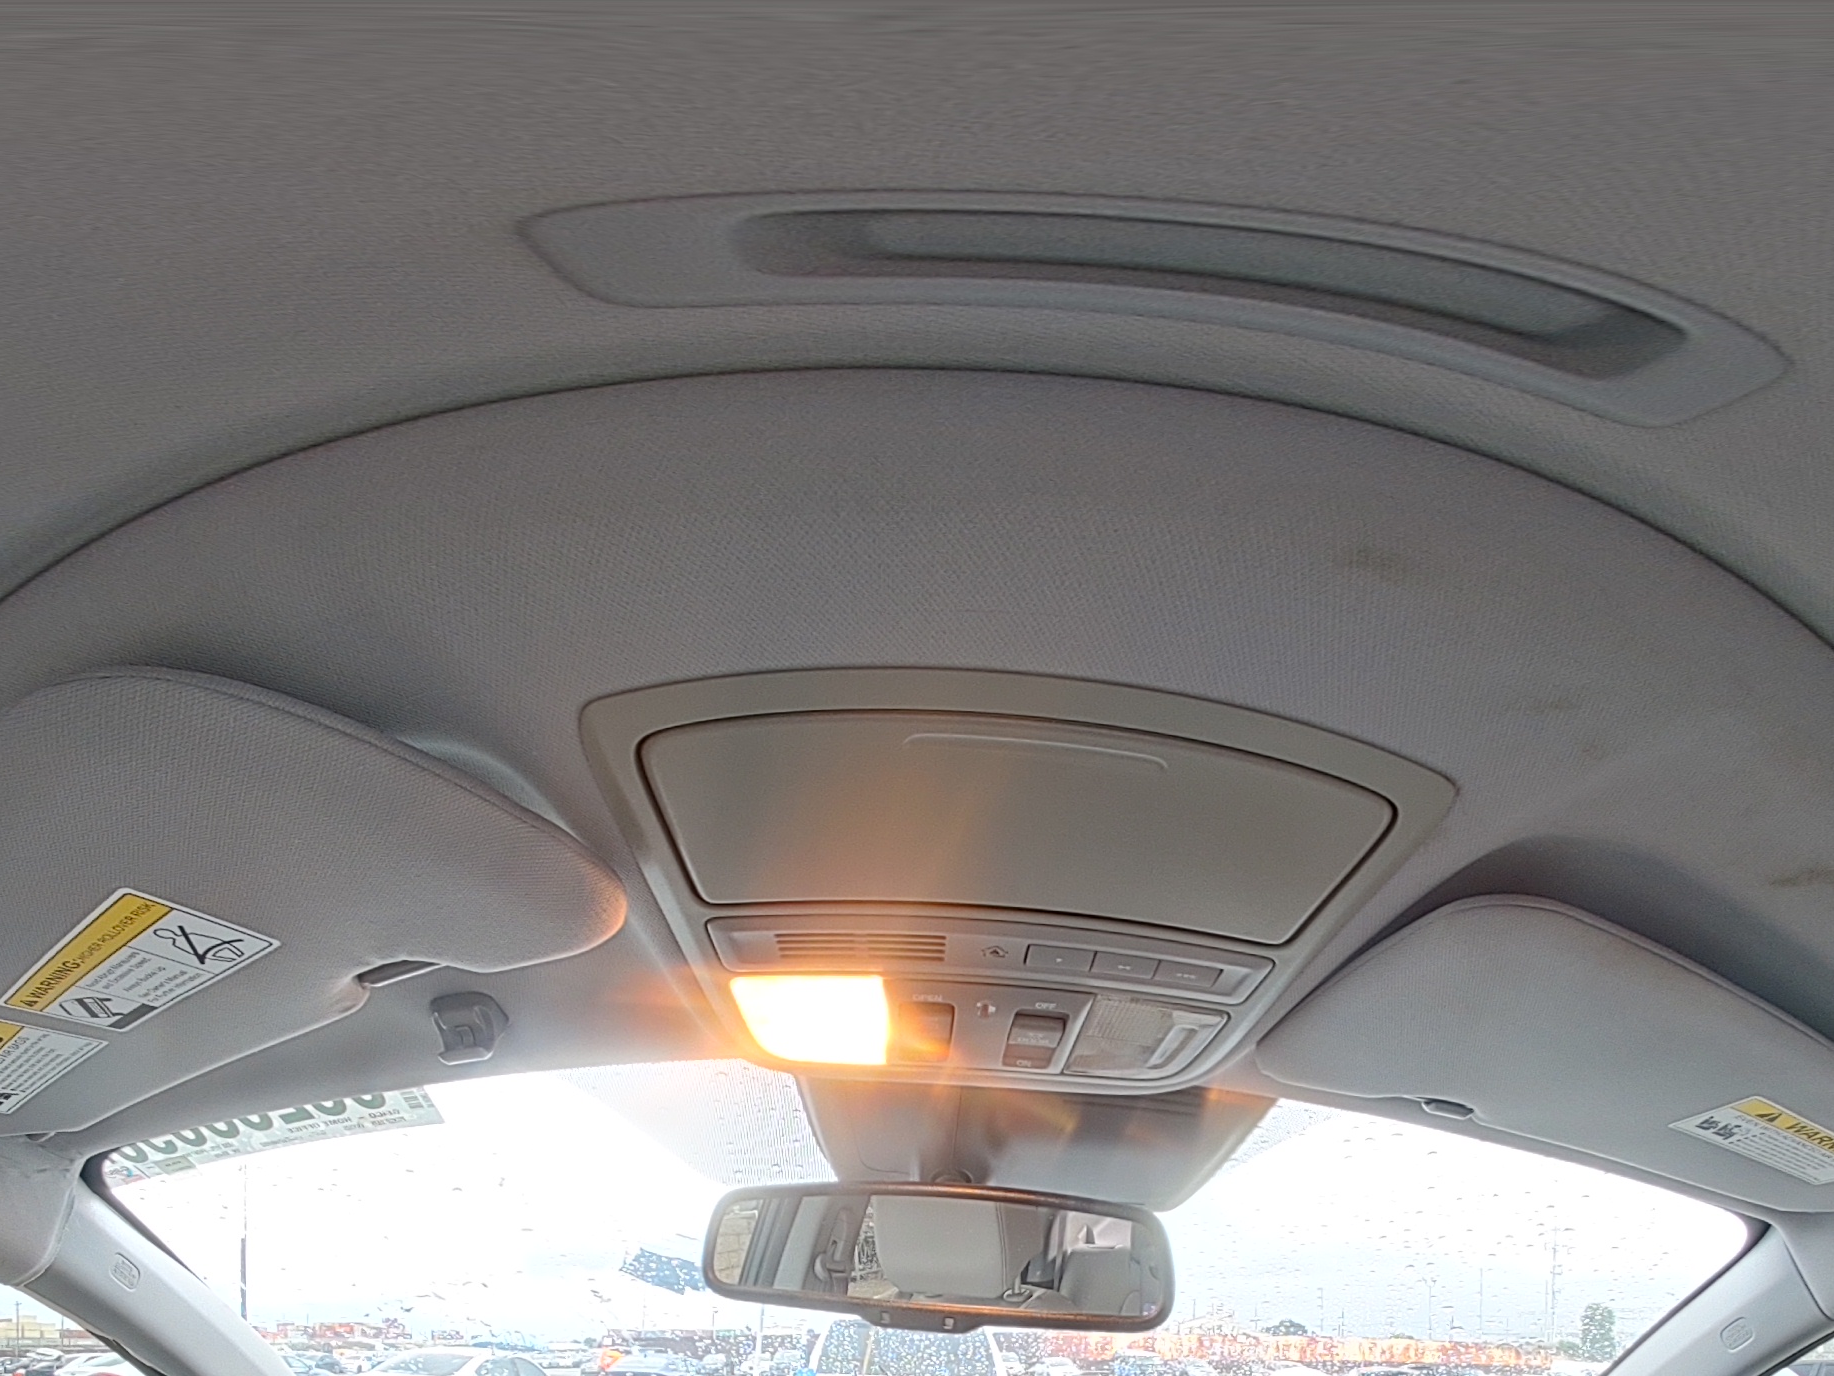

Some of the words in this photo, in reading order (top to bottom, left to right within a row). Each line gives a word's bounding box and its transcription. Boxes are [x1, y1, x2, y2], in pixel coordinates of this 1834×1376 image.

[100, 915, 135, 945] ROLLOVER
[912, 993, 943, 1002] OPEN
[1016, 1059, 1032, 1067] ON
